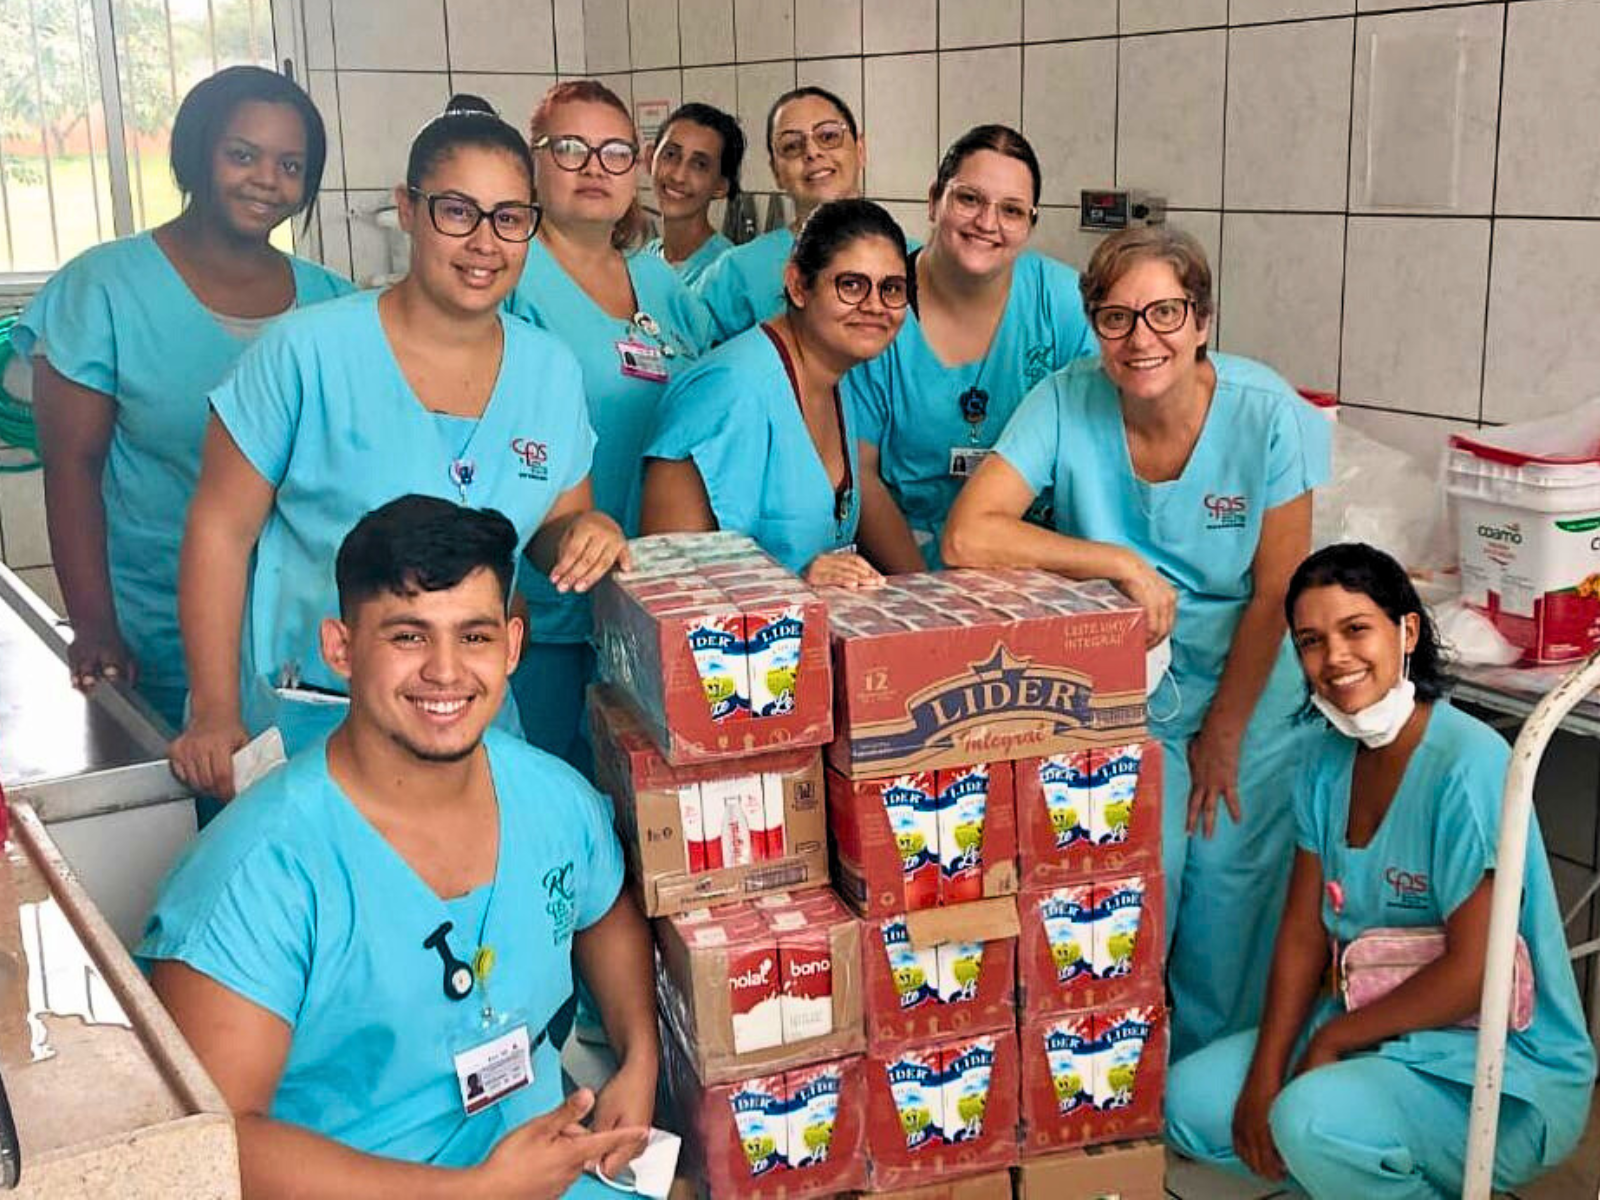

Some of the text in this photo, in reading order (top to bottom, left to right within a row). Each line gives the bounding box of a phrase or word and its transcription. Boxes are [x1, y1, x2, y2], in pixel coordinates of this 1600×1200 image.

[1478, 524, 1523, 544] coamo
[864, 671, 889, 691] 12
[931, 679, 1076, 726] LIDER
